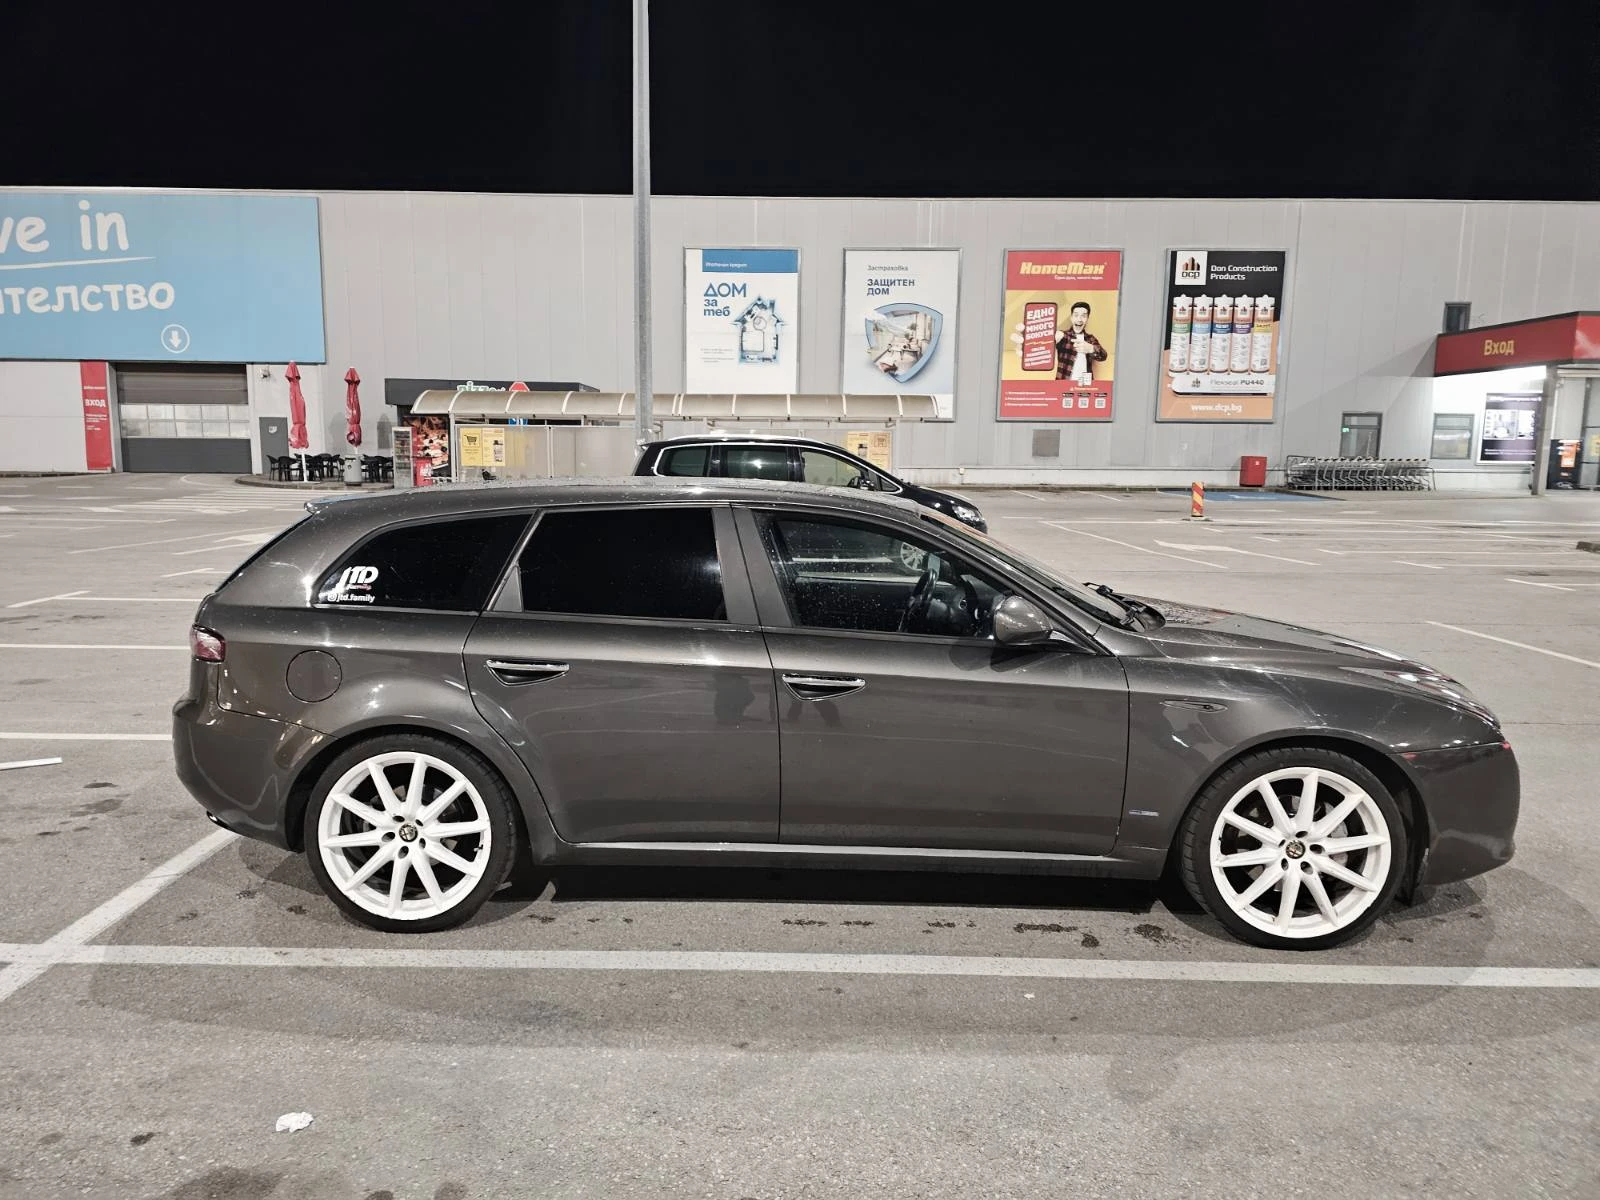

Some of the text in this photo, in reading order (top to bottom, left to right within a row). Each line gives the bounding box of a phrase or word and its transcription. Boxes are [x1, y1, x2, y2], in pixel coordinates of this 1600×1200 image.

[79, 200, 129, 251] in
[1020, 262, 1104, 275] HomeMax
[867, 278, 915, 287] ЗАЩИТЕН
[704, 282, 747, 298] ДОМ
[867, 287, 890, 296] ДОМ
[0, 282, 175, 315] телство
[704, 299, 718, 307] за
[1026, 307, 1055, 320] ЕДНО
[1484, 339, 1515, 355] Вход
[1191, 403, 1242, 413] www.dcp.bg
